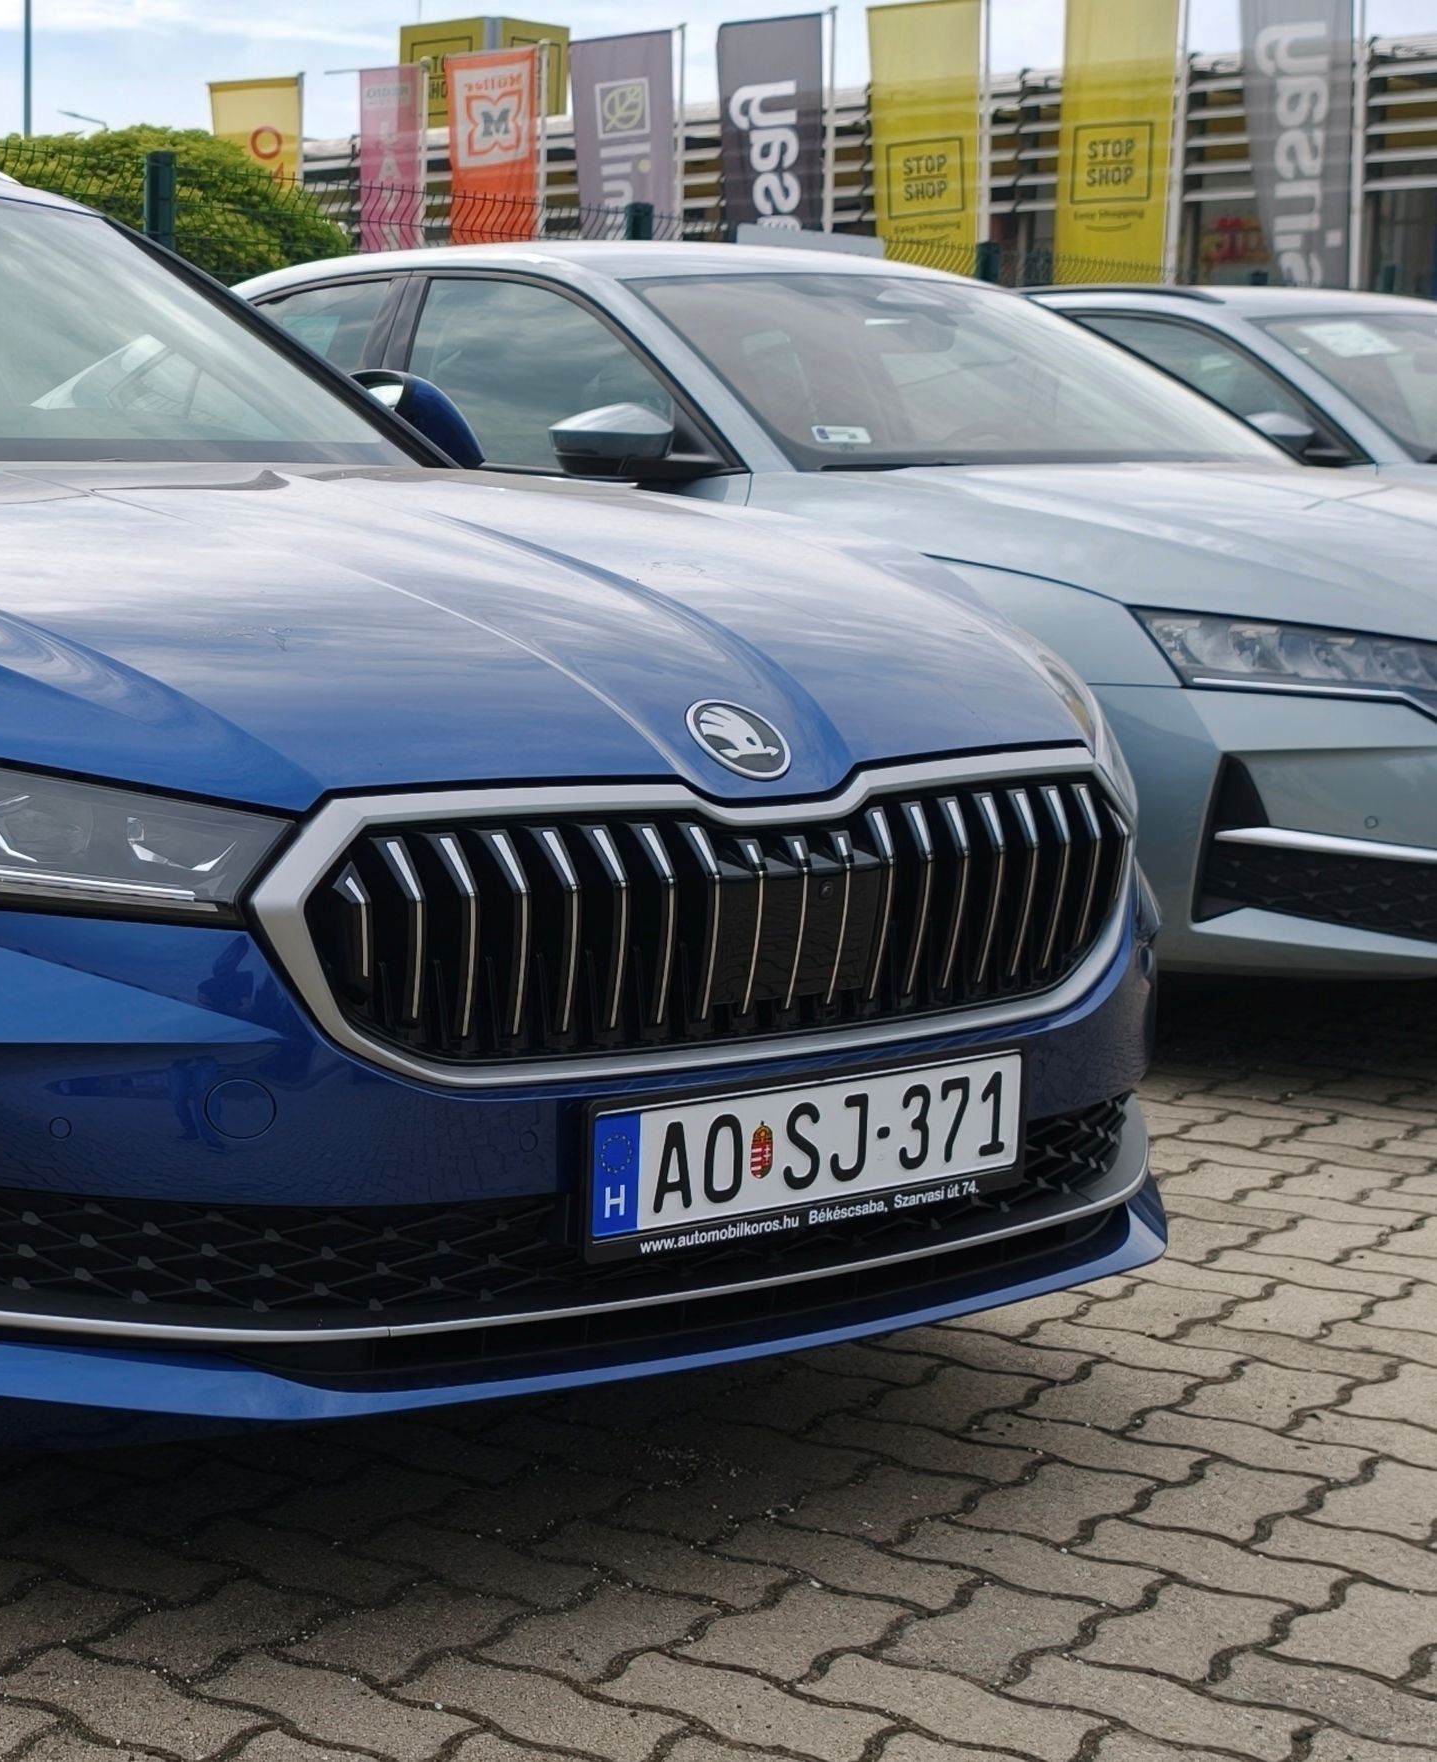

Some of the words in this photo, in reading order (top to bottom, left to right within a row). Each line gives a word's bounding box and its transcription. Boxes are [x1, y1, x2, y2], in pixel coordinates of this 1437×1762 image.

[1087, 138, 1136, 160] STOP
[902, 154, 947, 176] STOP
[1085, 165, 1135, 187] SHOP
[903, 180, 948, 202] SHOP
[604, 1183, 626, 1219] H
[639, 1214, 800, 1254] www.automobilkoros.hu
[808, 1200, 889, 1225] Békéscsaba,
[893, 1186, 946, 1209] Szarvasi
[947, 1181, 961, 1198] út
[962, 1180, 980, 1196] 74.
